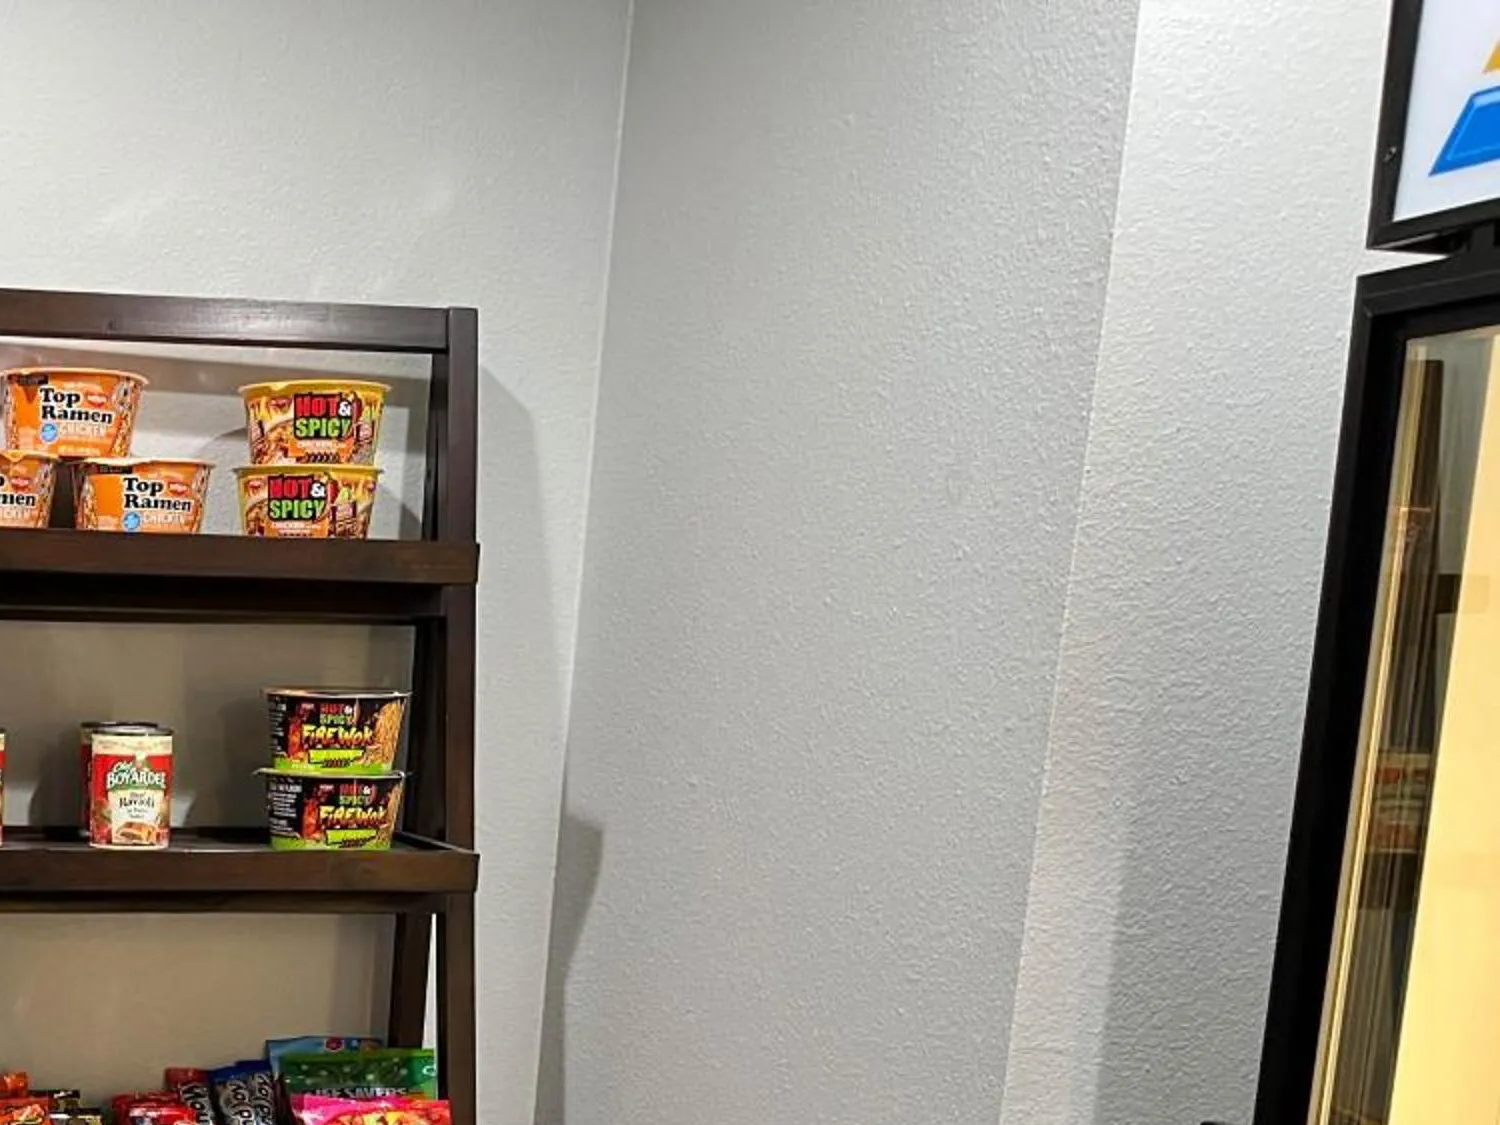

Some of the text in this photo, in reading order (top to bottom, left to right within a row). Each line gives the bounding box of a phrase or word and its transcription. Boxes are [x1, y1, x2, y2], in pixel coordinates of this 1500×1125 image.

[40, 386, 81, 409] Top
[296, 395, 352, 417] HOT &
[41, 404, 114, 424] Ramen
[295, 417, 352, 437] SPICY
[123, 477, 164, 497] Top
[269, 478, 326, 498] HOT &
[123, 493, 192, 512] Ramen
[269, 499, 326, 519] SPICY
